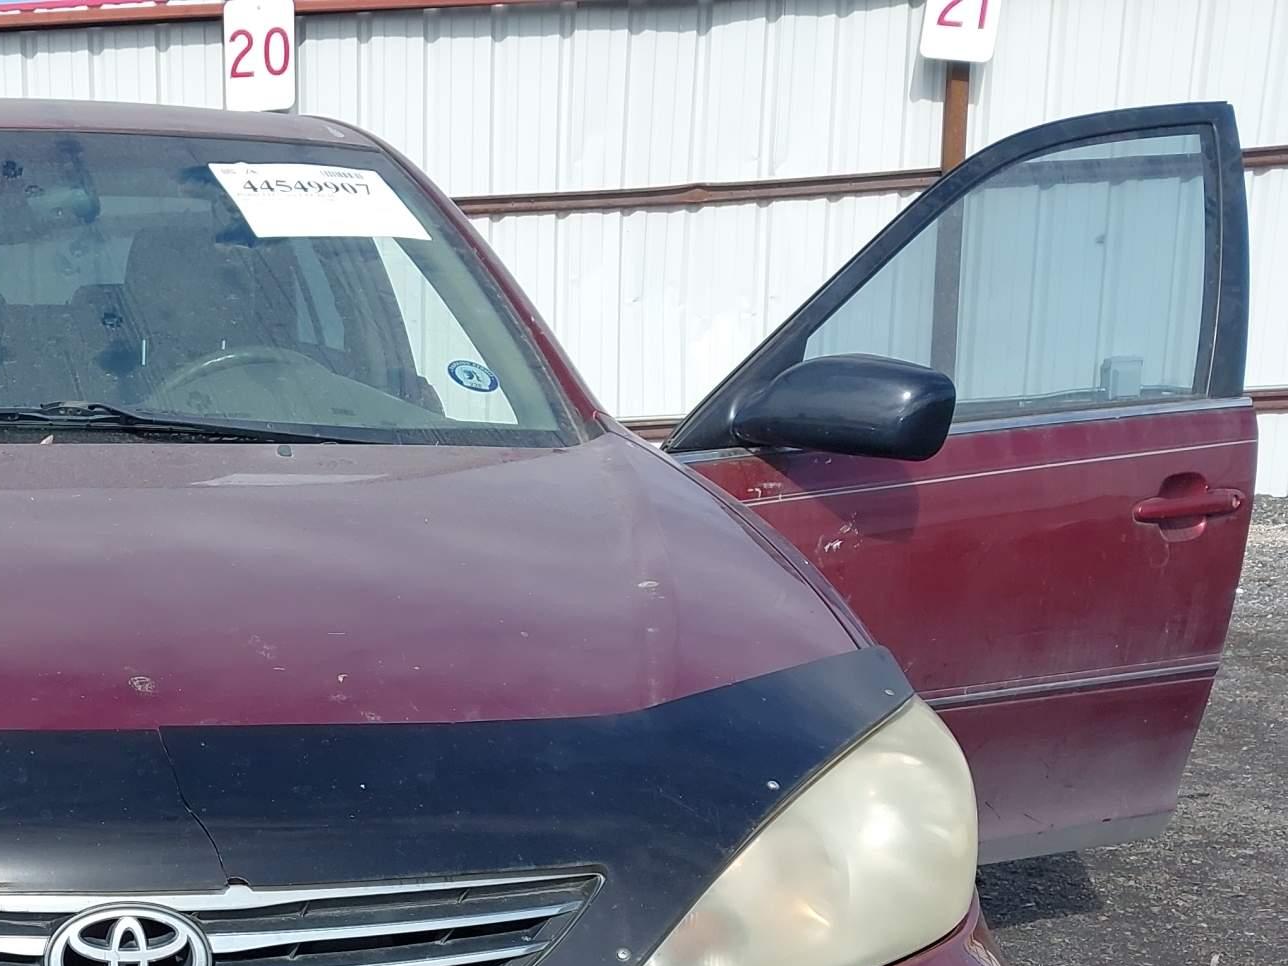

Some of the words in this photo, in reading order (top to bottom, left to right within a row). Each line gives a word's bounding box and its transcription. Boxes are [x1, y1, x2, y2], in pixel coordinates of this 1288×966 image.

[936, 0, 988, 29] 21
[229, 26, 290, 78] 20
[242, 179, 371, 196] 44549907
